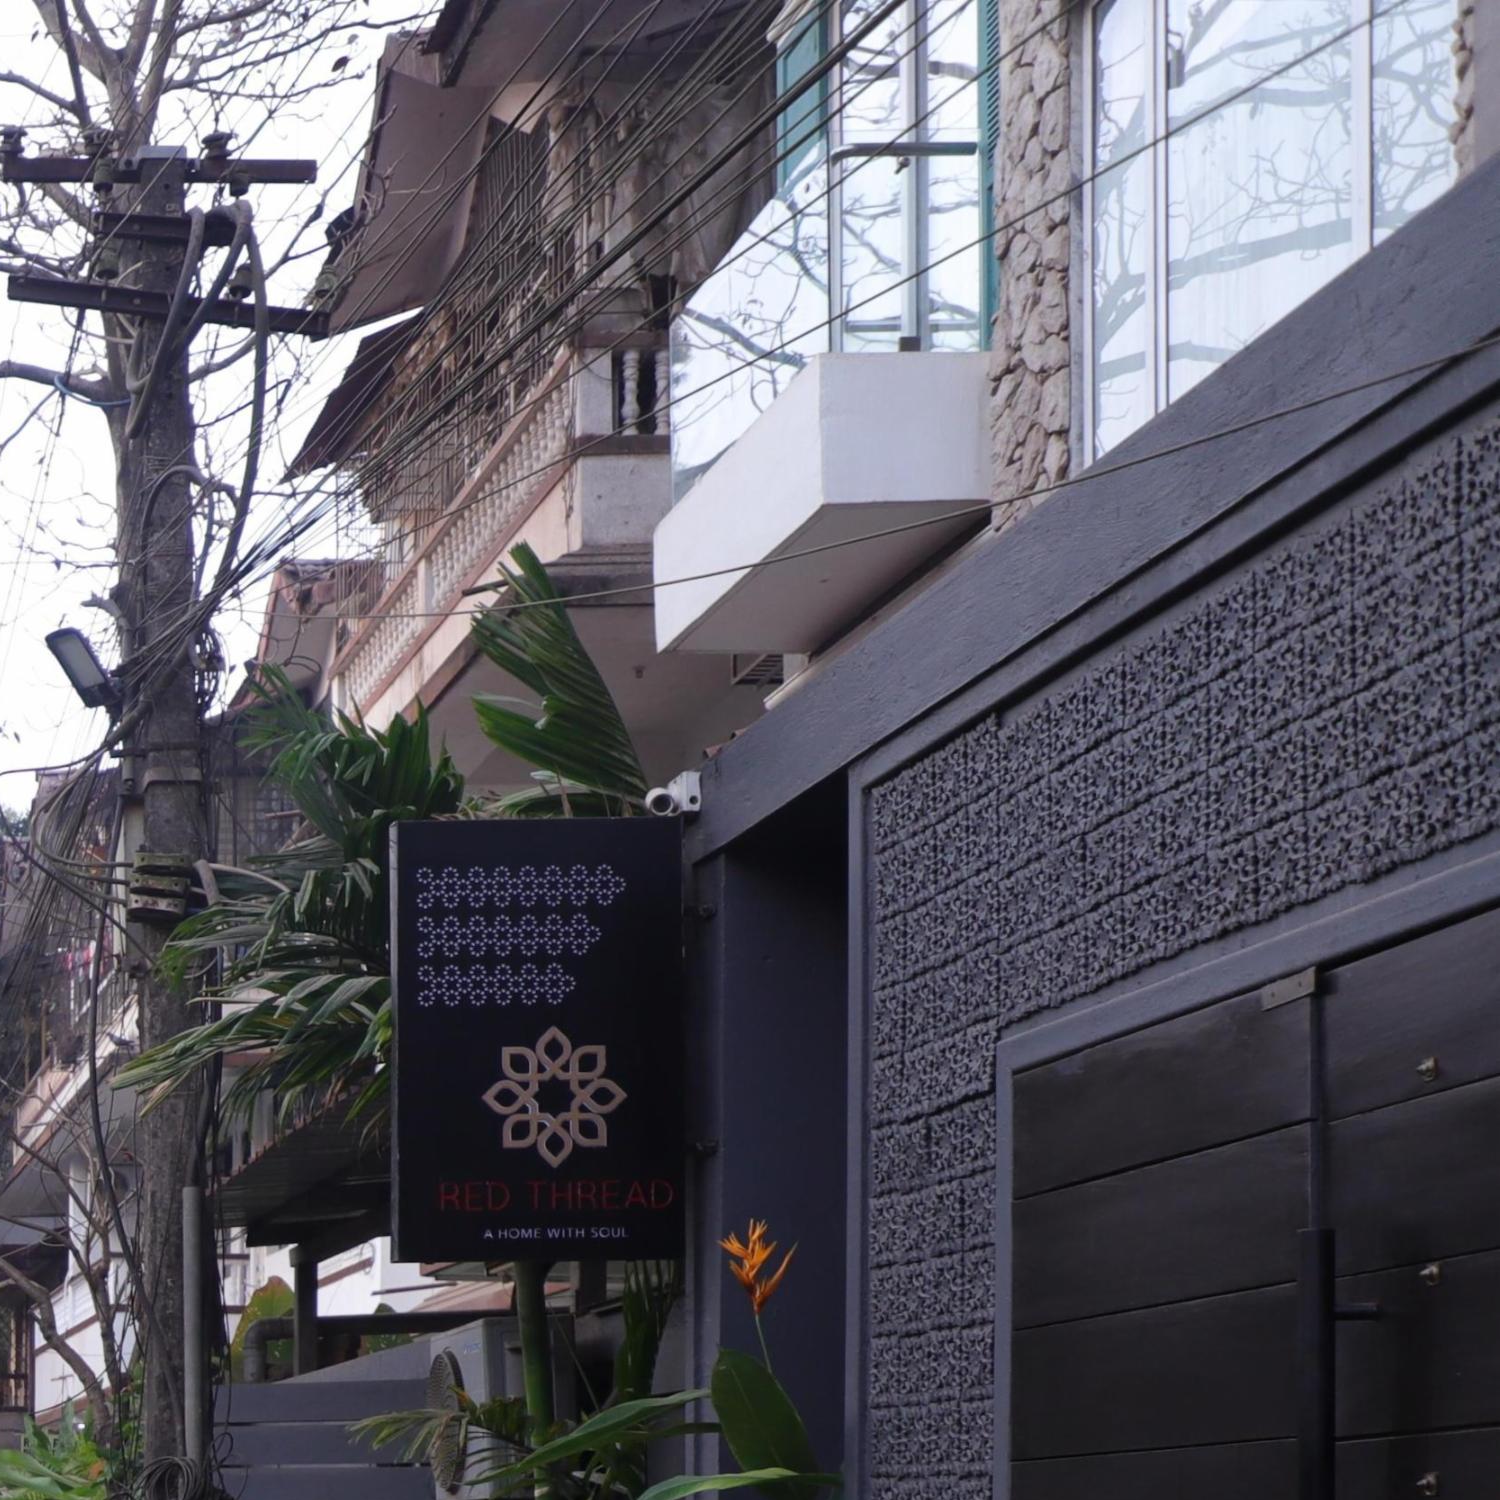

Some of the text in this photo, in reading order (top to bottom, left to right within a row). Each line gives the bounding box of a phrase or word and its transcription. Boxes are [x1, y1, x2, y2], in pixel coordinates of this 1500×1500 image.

[438, 1179, 674, 1212] RED THREAD
[483, 1227, 630, 1239] A HOME WITH SOUL
